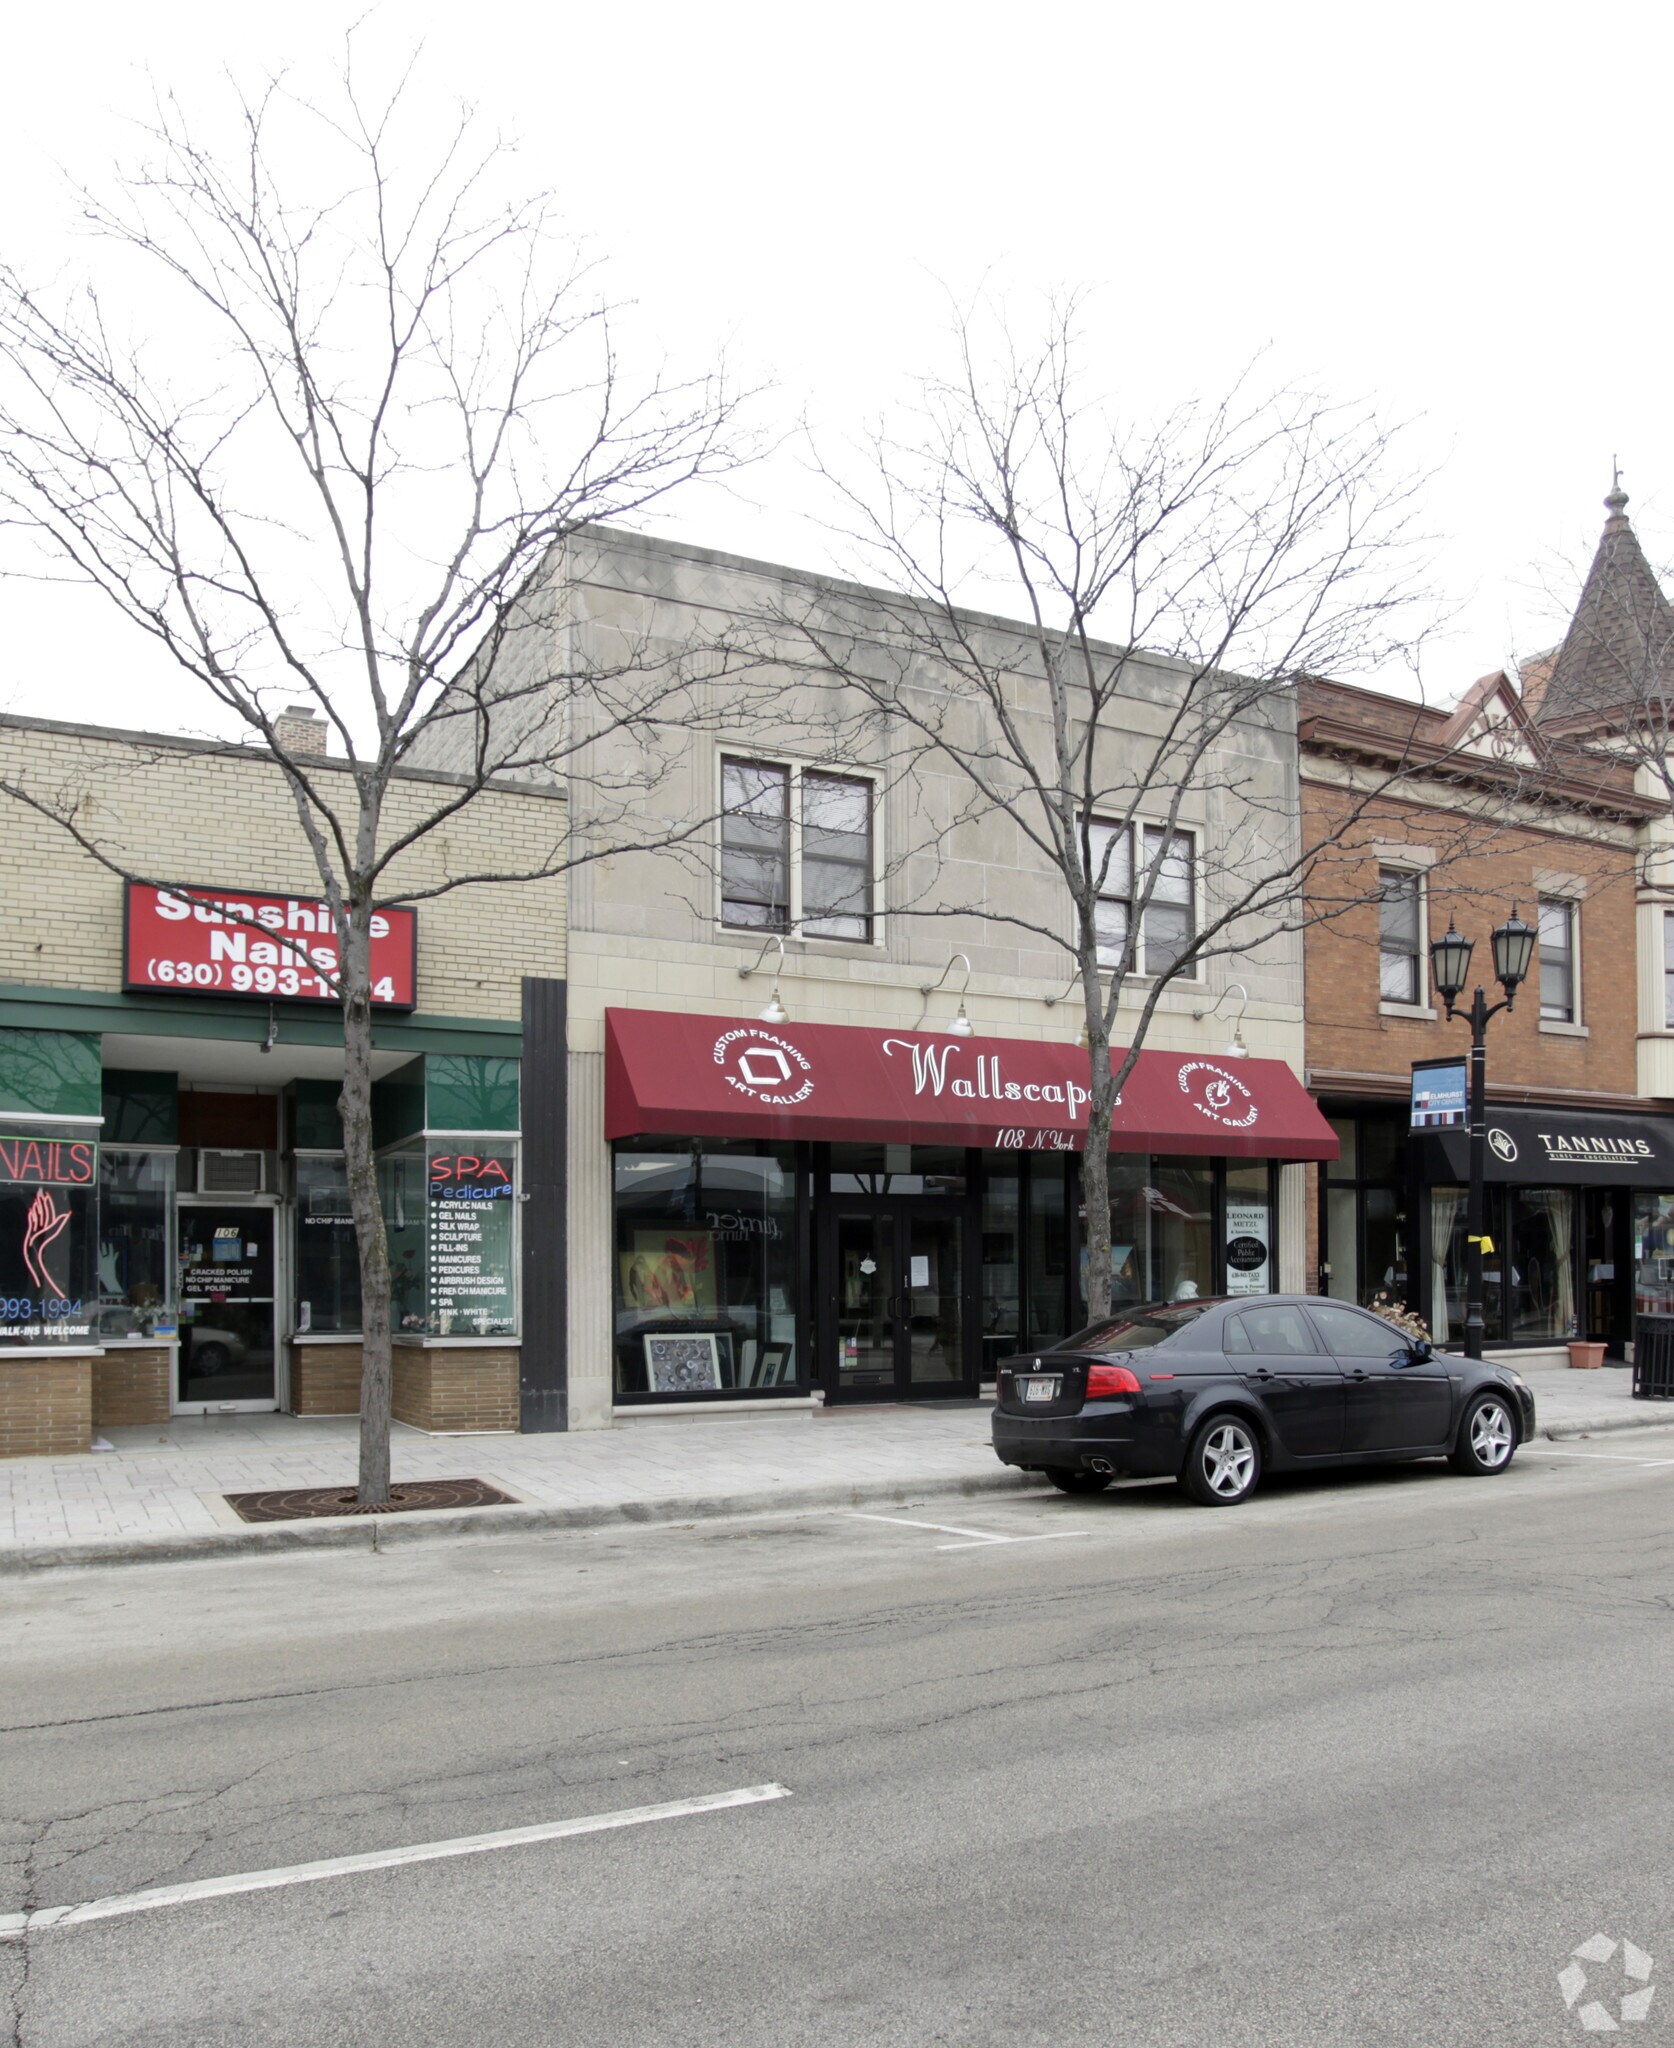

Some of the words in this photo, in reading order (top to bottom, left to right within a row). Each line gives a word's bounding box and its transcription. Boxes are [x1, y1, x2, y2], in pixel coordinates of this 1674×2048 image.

[155, 889, 390, 938] Sunshie
[210, 930, 337, 970] Nails
[147, 958, 222, 986] (630)
[231, 965, 395, 1002] 993-14
[713, 1029, 748, 1065] CUSTOM
[749, 1029, 811, 1071] FRAMING
[882, 1039, 1122, 1120] Wallscaps
[1177, 1062, 1198, 1094] CUSTOM
[1198, 1062, 1251, 1098] FRAMING
[724, 1075, 757, 1097] ART
[759, 1079, 815, 1105] GALLERY
[1430, 1090, 1464, 1100] ELMHURST
[1193, 1102, 1220, 1121] ART
[1222, 1104, 1259, 1127] GALLERY
[995, 1128, 1026, 1149] 108
[1049, 1129, 1075, 1151] York
[1537, 1134, 1651, 1154] TANNINS
[0, 1140, 91, 1182] NAILS
[431, 1155, 510, 1182] SPA
[429, 1181, 512, 1199] Pedicure
[439, 1201, 471, 1210] ACRYLIC
[471, 1201, 493, 1210] NAILS
[439, 1212, 454, 1220] GEL
[454, 1212, 477, 1220] NAILS
[439, 1222, 455, 1231] SILK
[456, 1222, 480, 1231] WRAP
[217, 1228, 237, 1237] 106
[439, 1233, 483, 1241] SCULPTURE
[438, 1244, 468, 1252] FILL-INS
[438, 1255, 481, 1263] MANICURES
[190, 1268, 225, 1276] CRACKED
[227, 1268, 253, 1276] POLISH
[438, 1266, 480, 1274] PEDICURES
[185, 1276, 196, 1284] NO
[197, 1276, 213, 1284] CHIP
[213, 1276, 250, 1284] MANICURE
[438, 1276, 476, 1284] AIRBRUSH
[477, 1276, 504, 1284] DESIGN
[469, 1287, 507, 1295] MANICURE
[438, 1298, 454, 1306] SPA
[439, 1308, 458, 1316] PINK
[462, 1308, 488, 1316] WHITE
[472, 1318, 514, 1326] SPECIALIST
[43, 1325, 90, 1336] WELCOME
